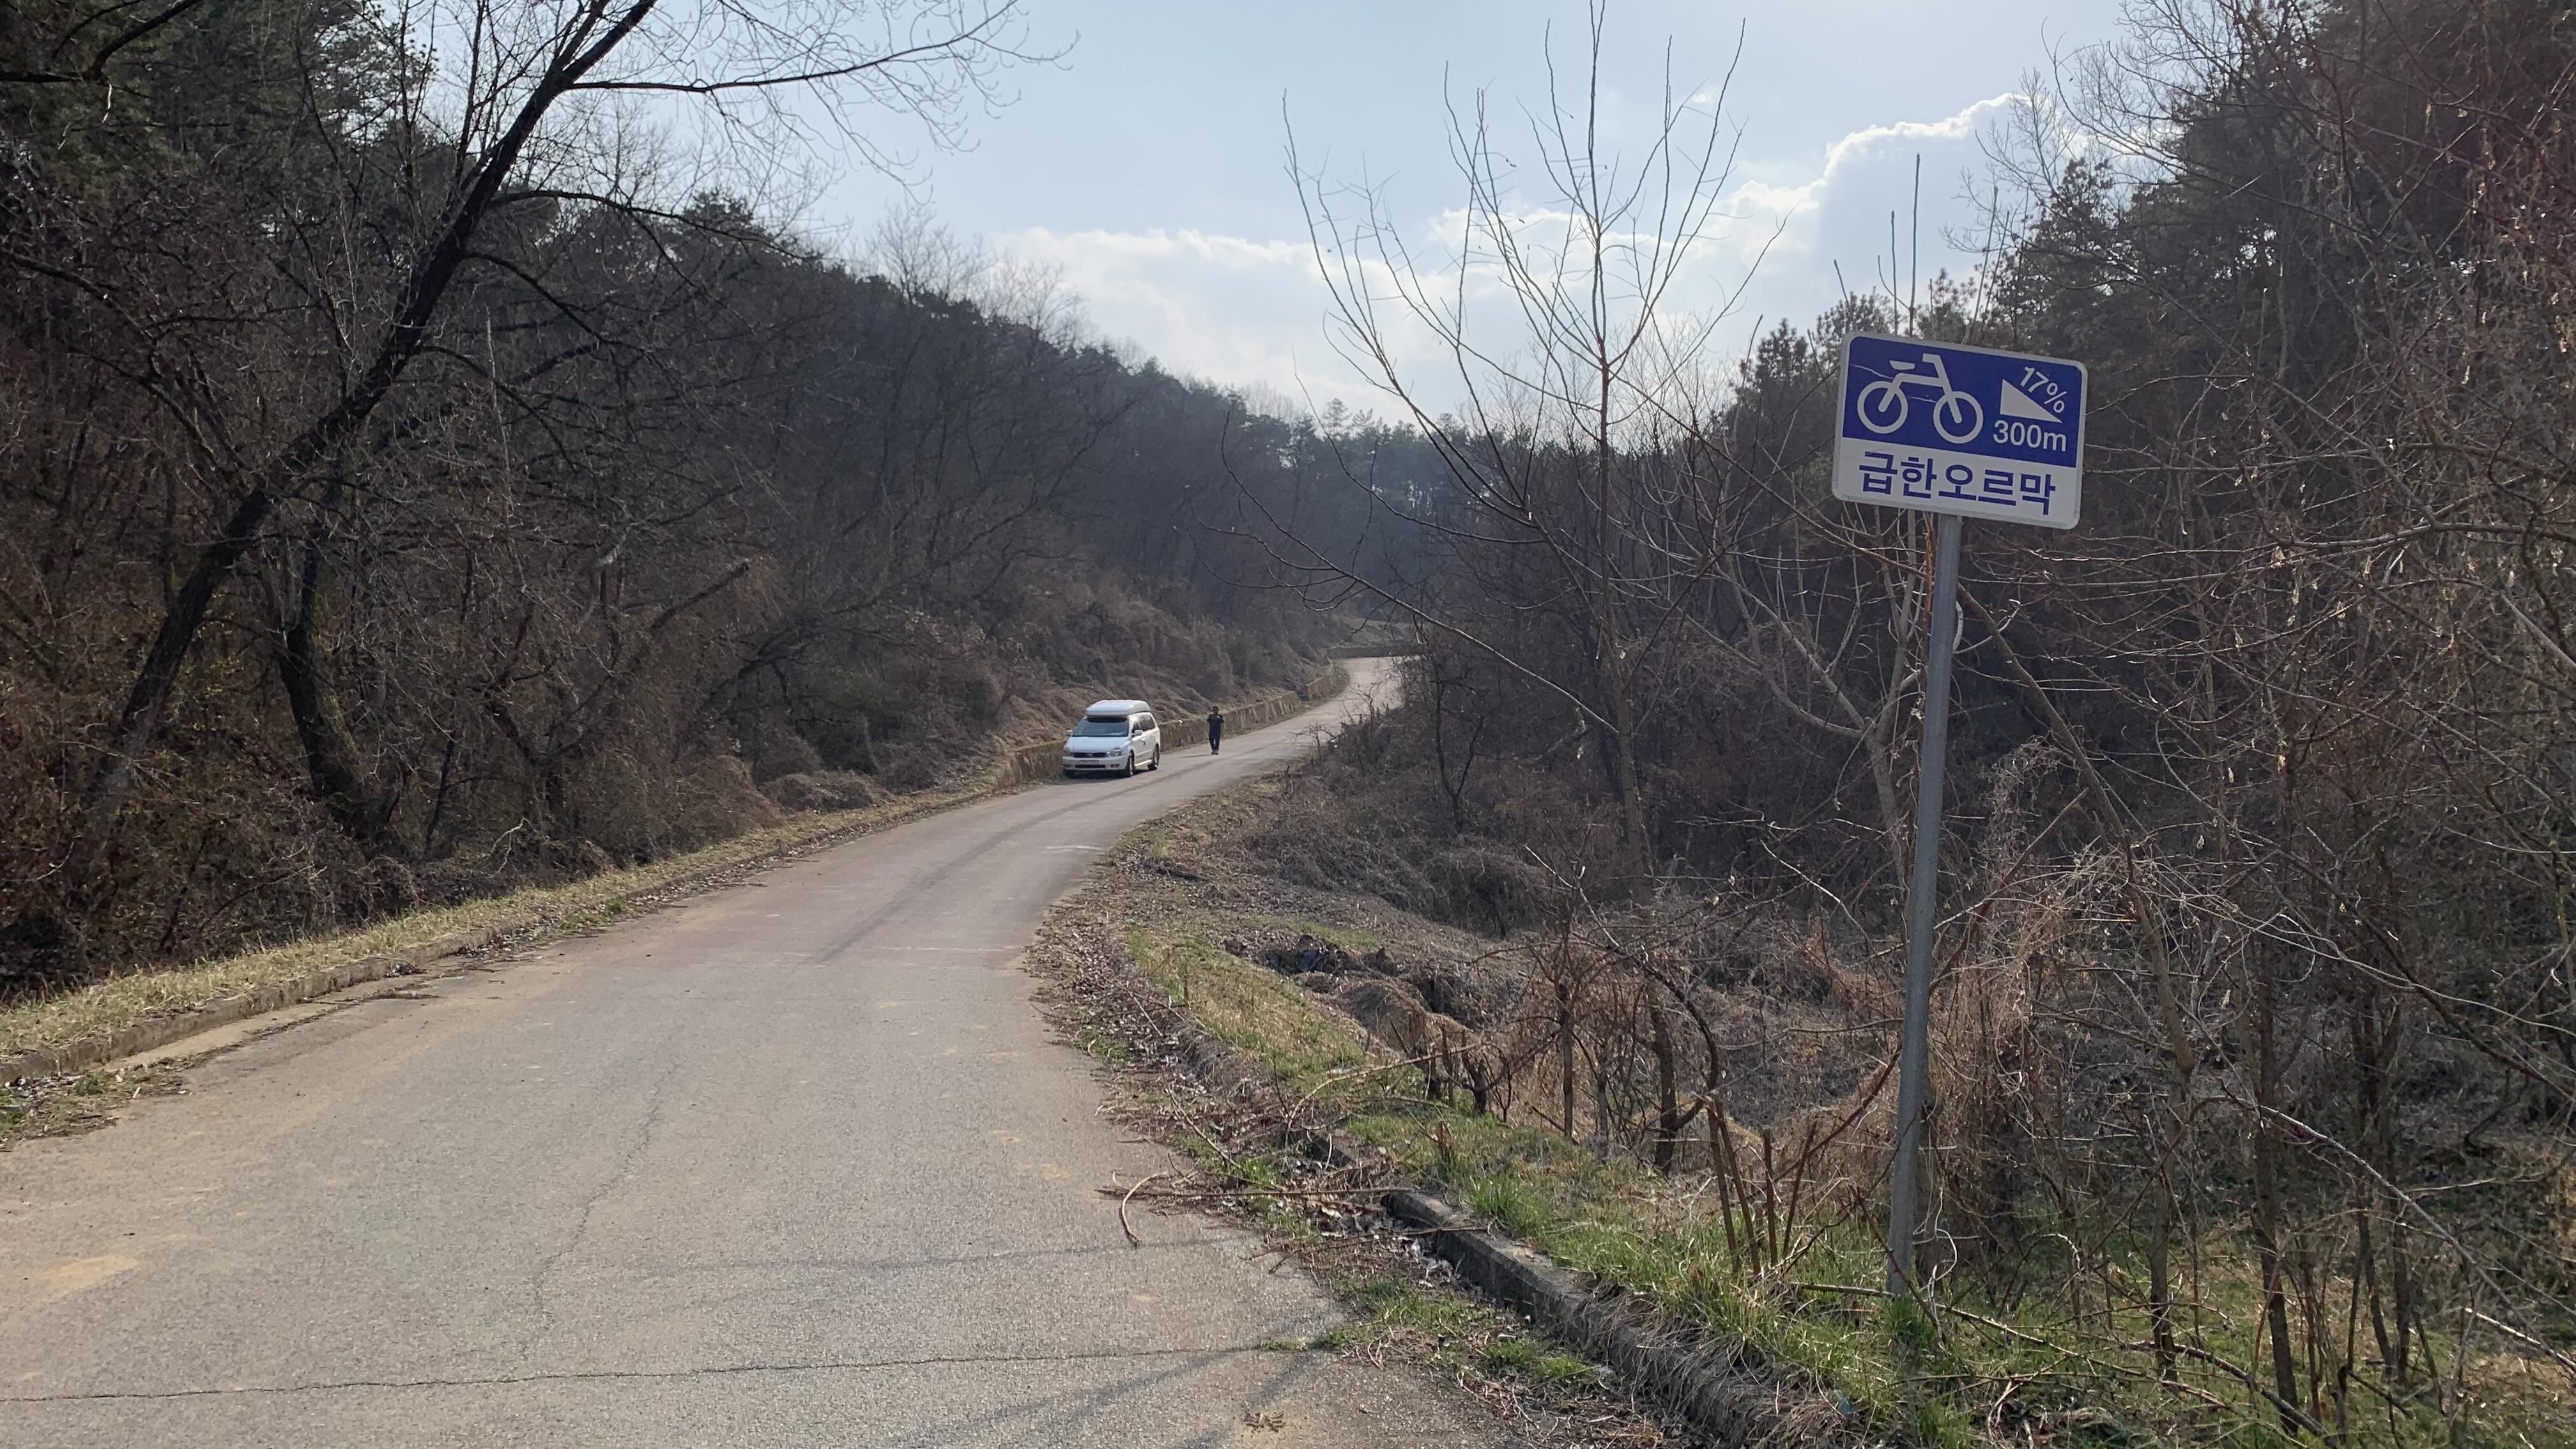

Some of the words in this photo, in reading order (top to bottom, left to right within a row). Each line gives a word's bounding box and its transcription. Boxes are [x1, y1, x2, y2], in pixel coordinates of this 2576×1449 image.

[2020, 366, 2067, 413] 17%
[1993, 420, 2067, 452] 300m
[1859, 451, 2056, 516] 급한오르막
